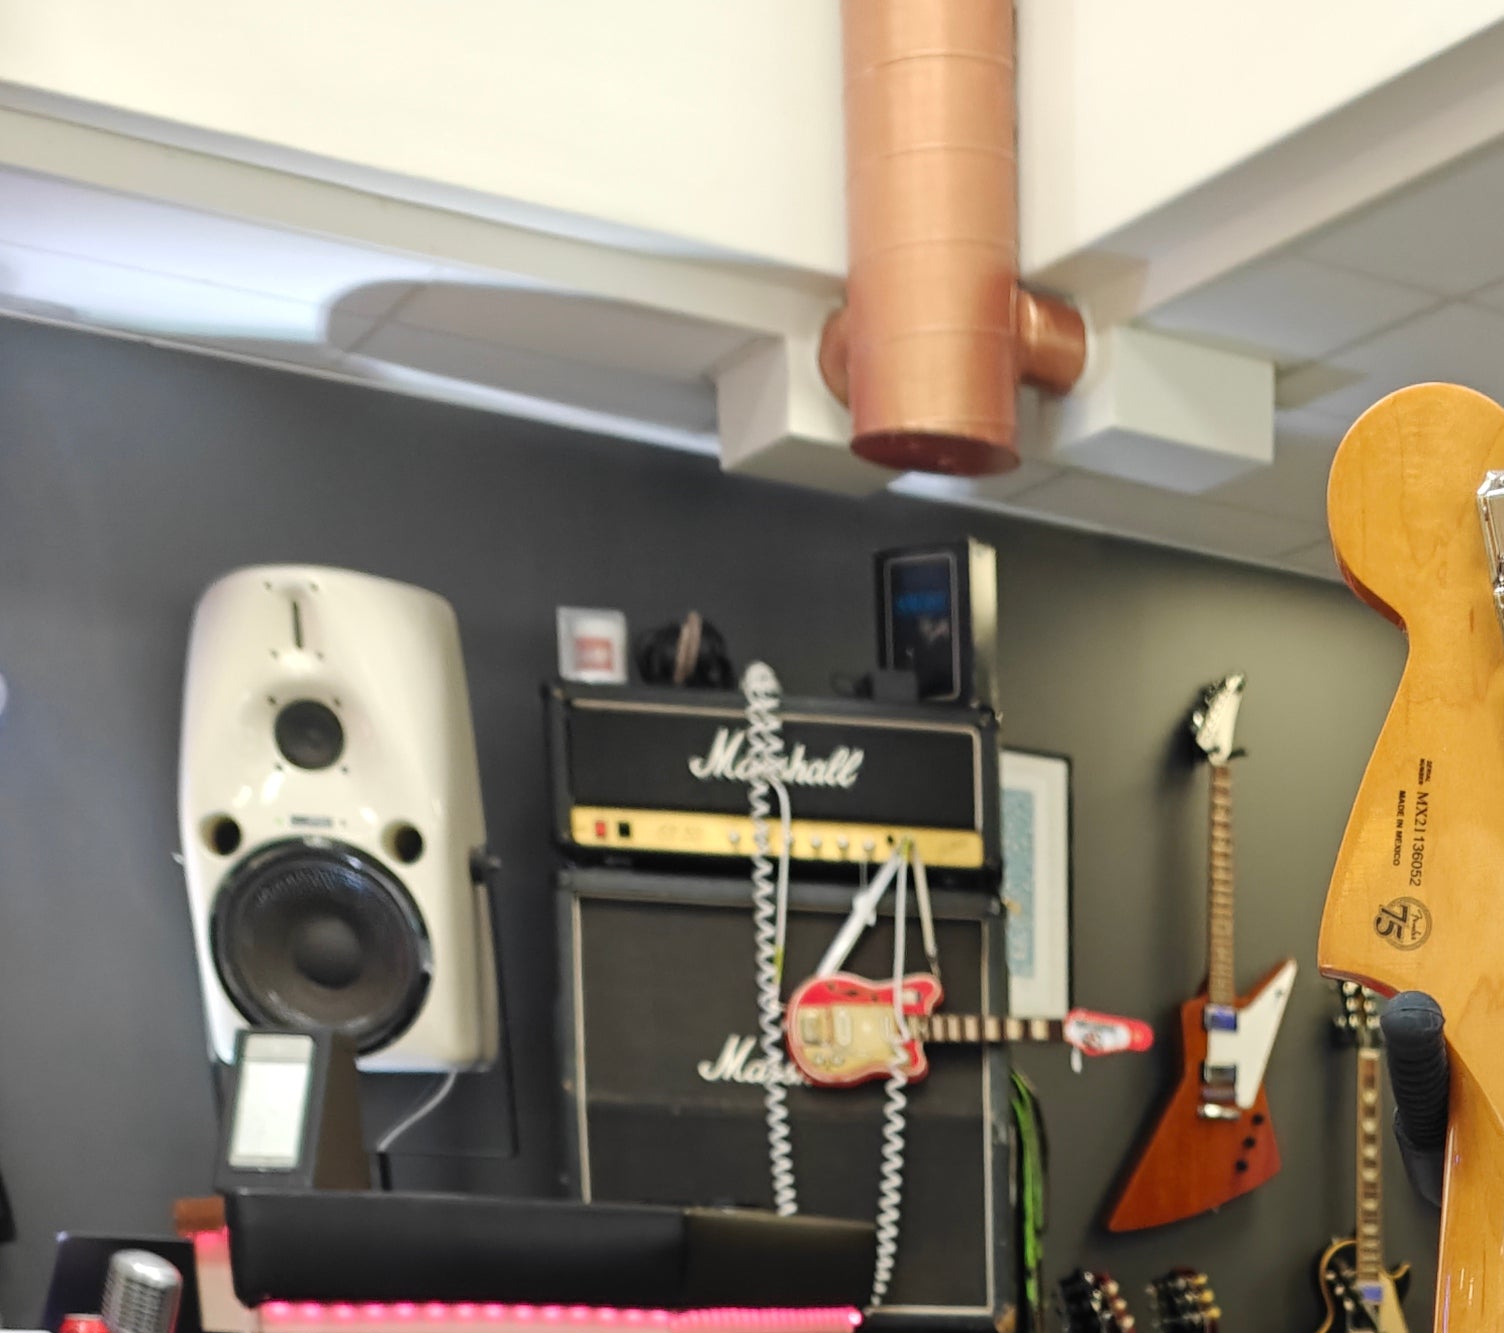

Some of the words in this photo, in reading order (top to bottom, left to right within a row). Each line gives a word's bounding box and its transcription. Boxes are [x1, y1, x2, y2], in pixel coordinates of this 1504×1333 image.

[688, 726, 865, 789] Mashall
[1396, 790, 1406, 817] MADE
[1396, 820, 1404, 829] IN
[1393, 830, 1403, 867] MEXICO
[1375, 904, 1409, 940] 75
